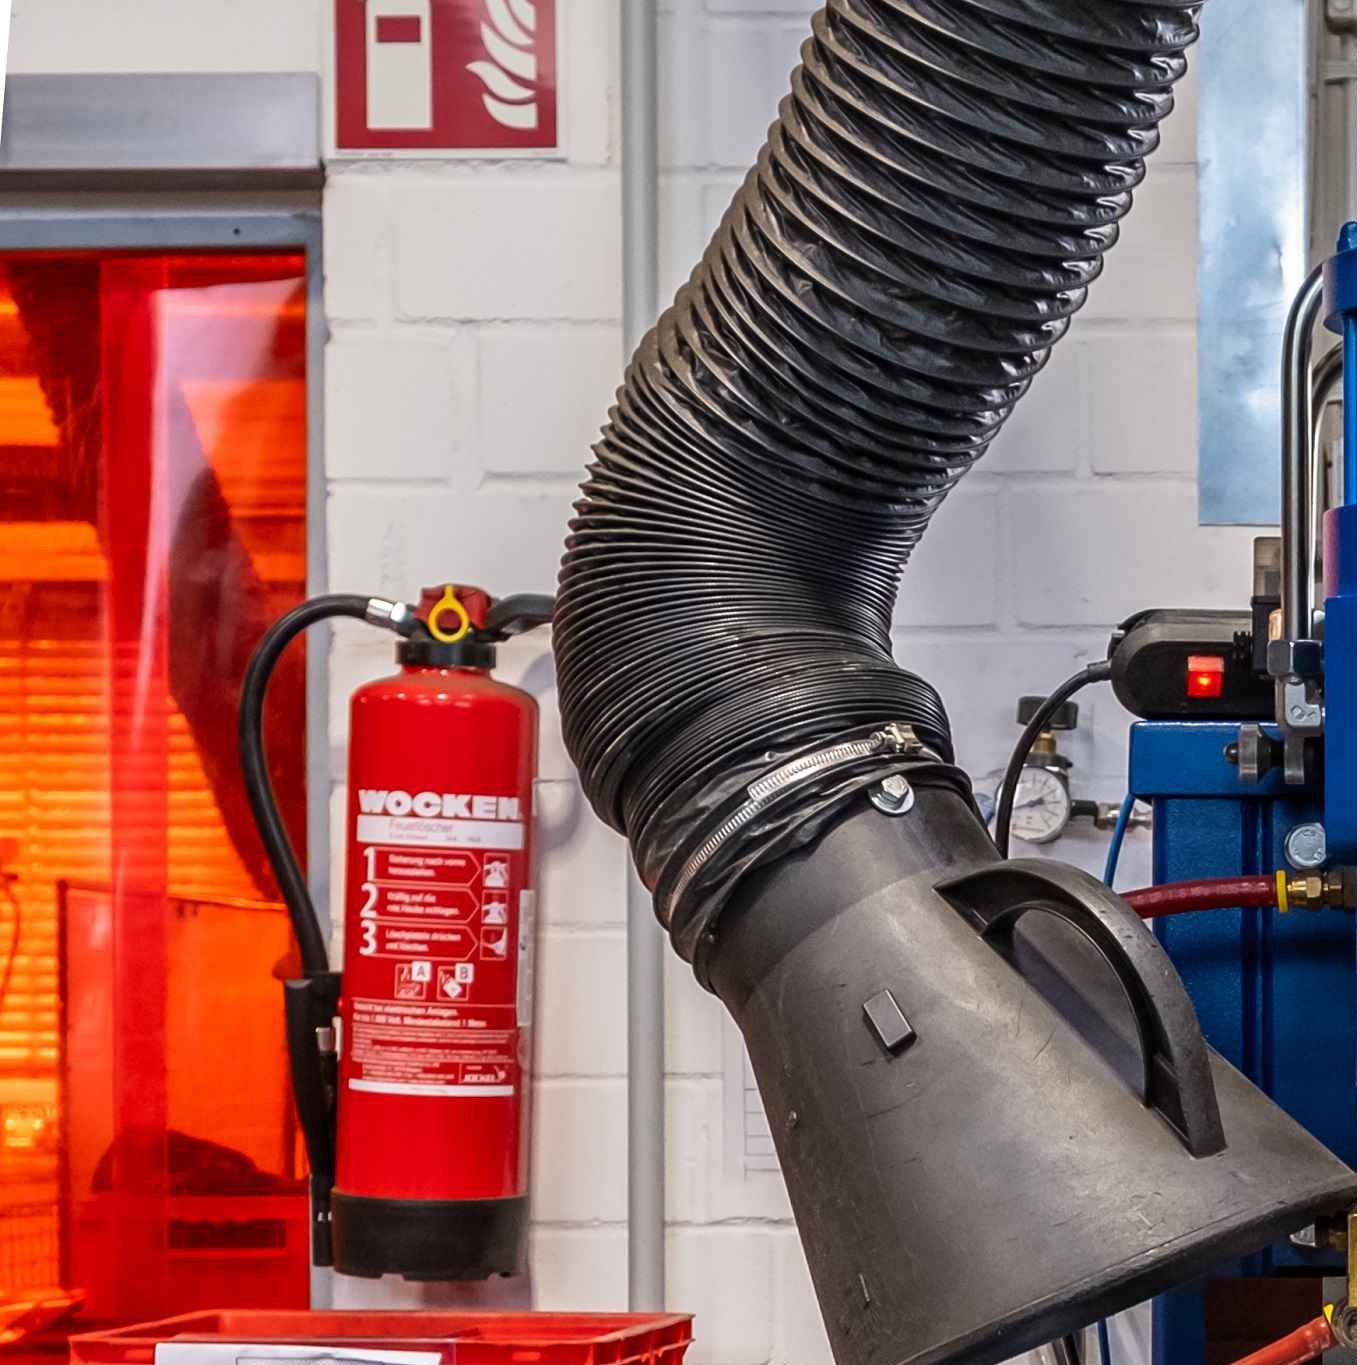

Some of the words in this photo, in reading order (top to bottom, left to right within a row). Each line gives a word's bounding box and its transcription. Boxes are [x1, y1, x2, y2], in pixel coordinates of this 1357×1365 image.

[363, 846, 376, 882] 1
[360, 882, 378, 918] 2
[359, 919, 377, 956] 3
[416, 965, 427, 978] A
[459, 966, 469, 980] B
